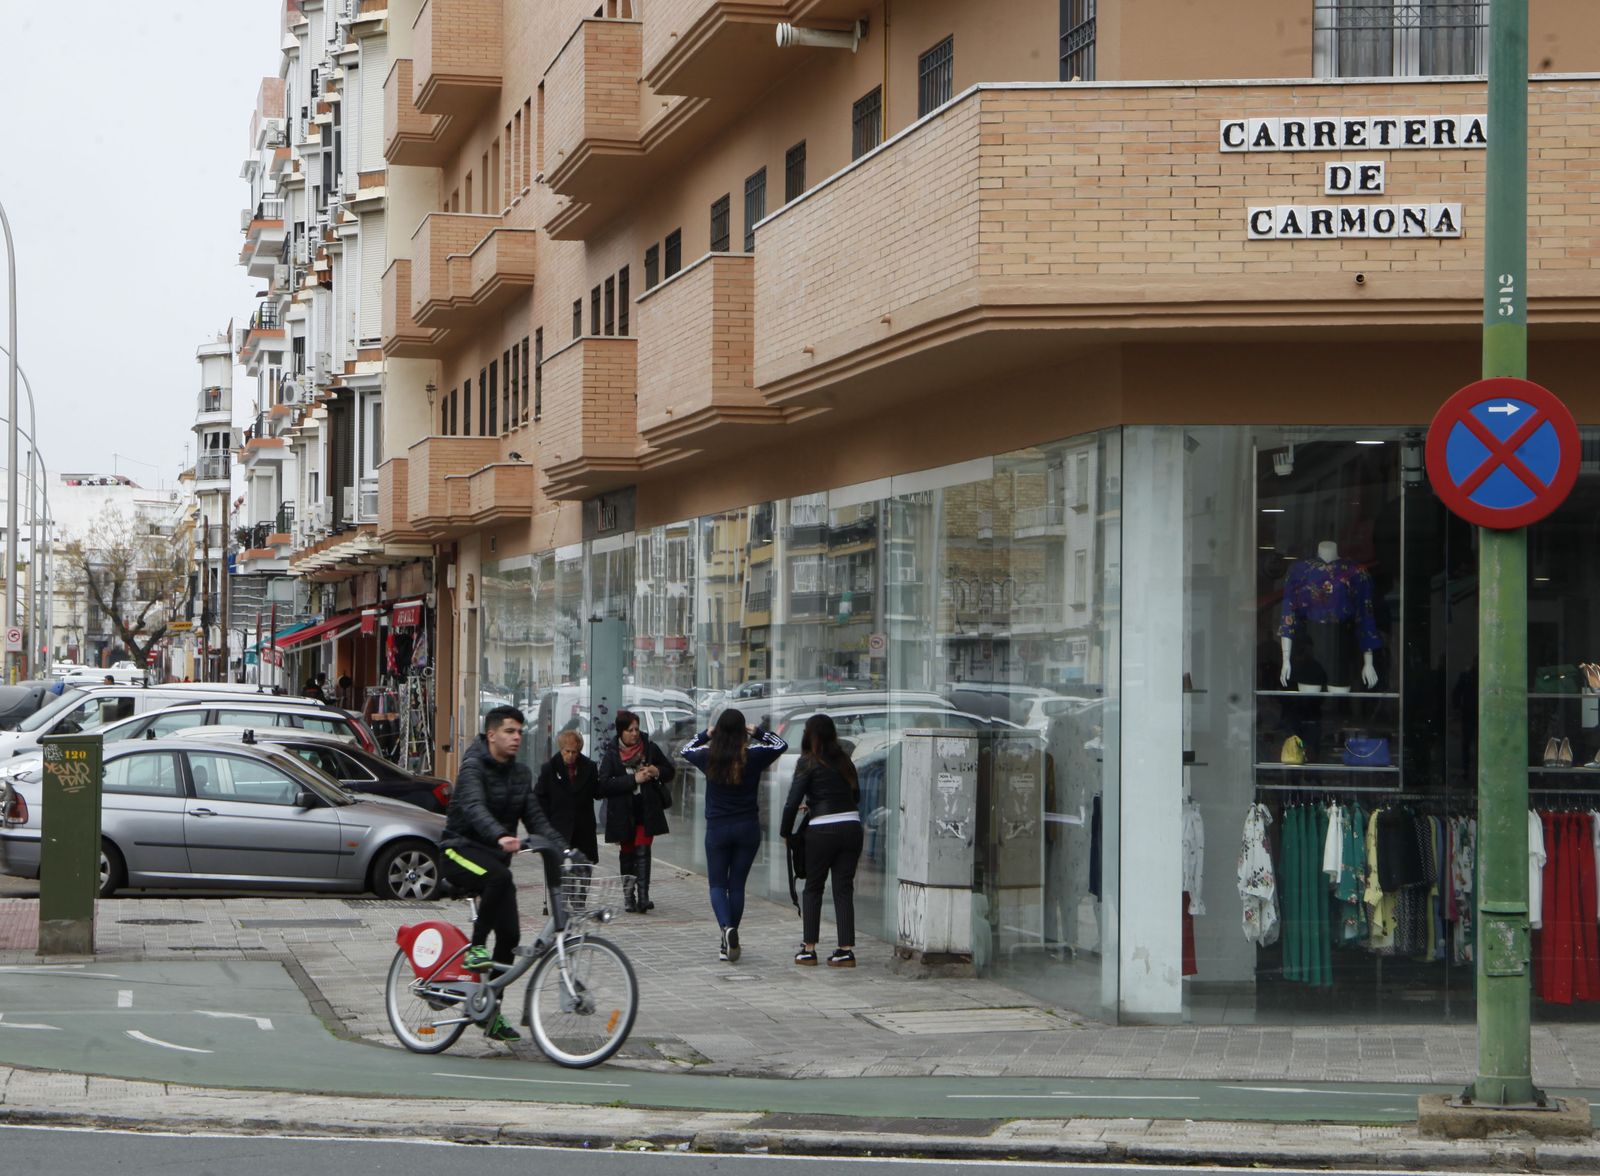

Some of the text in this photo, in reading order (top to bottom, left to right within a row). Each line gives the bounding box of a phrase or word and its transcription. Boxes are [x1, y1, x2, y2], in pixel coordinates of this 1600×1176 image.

[1222, 117, 1487, 147] CARRETERA
[1329, 165, 1381, 191] DE
[1250, 207, 1458, 235] CARMONA
[65, 750, 88, 760] 120
